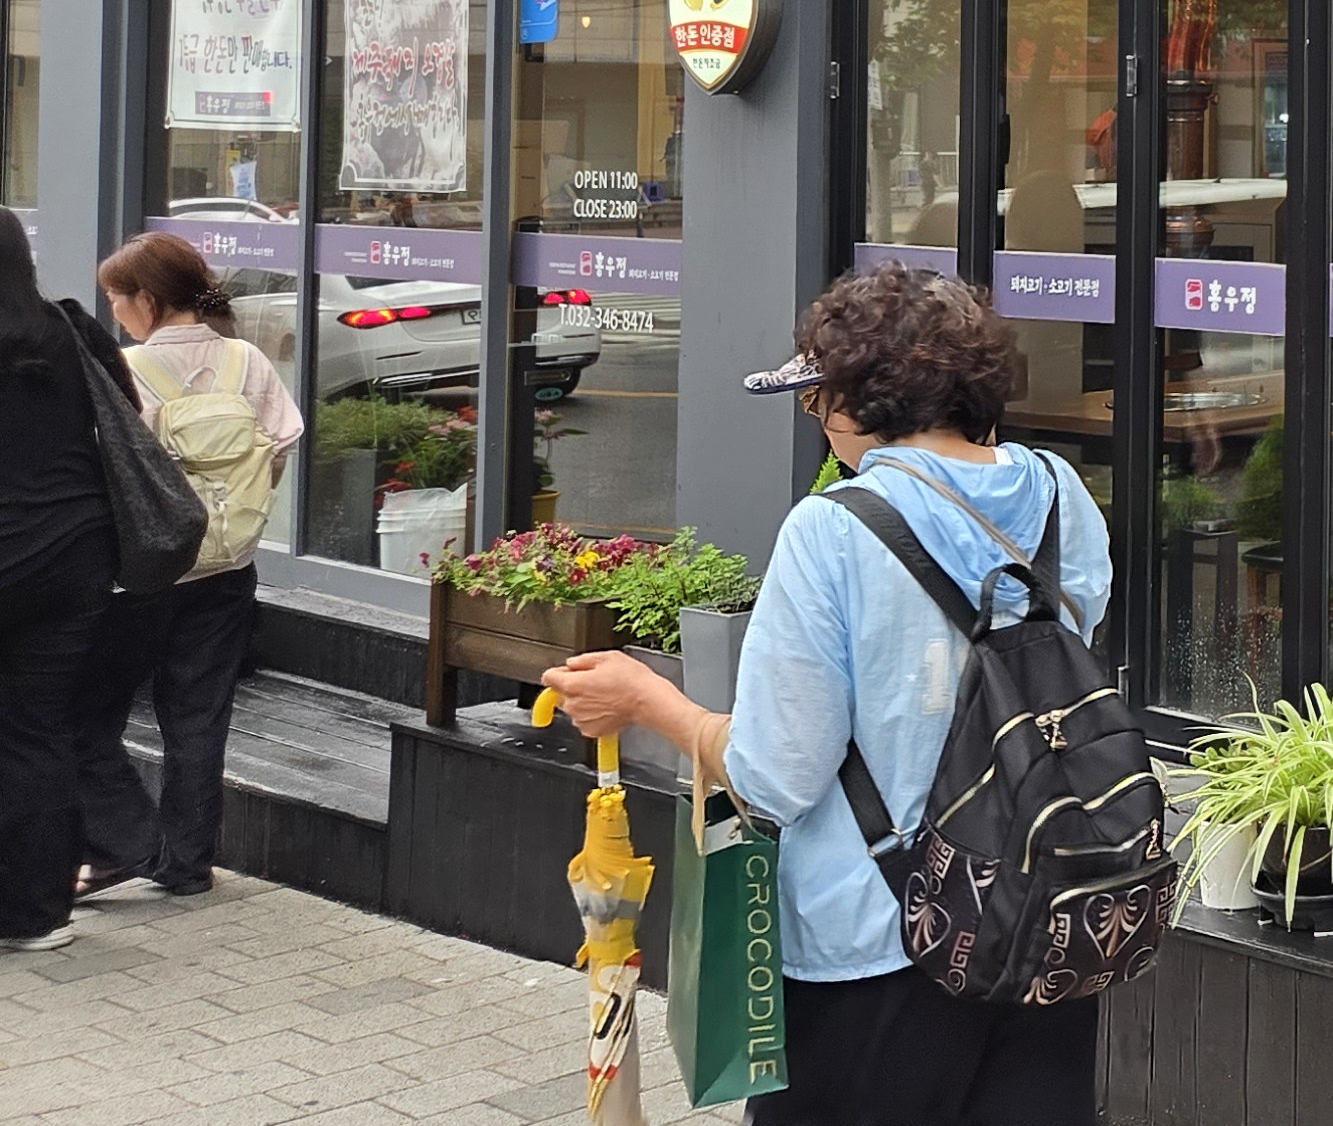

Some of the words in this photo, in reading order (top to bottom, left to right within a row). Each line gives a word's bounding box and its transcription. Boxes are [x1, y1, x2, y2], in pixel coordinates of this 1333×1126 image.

[674, 25, 699, 48] 한돈
[699, 23, 735, 49] 인증점
[574, 170, 608, 190] OPEN
[609, 171, 638, 190] 11:00
[573, 198, 608, 219] CLOSE
[609, 199, 638, 219] 23:00
[383, 240, 411, 267] 홍우정
[595, 251, 627, 279] 홍우정
[1207, 279, 1257, 315] 홍우정
[558, 302, 654, 334] T.032-346-8474
[745, 854, 778, 1084] CROCODILE
